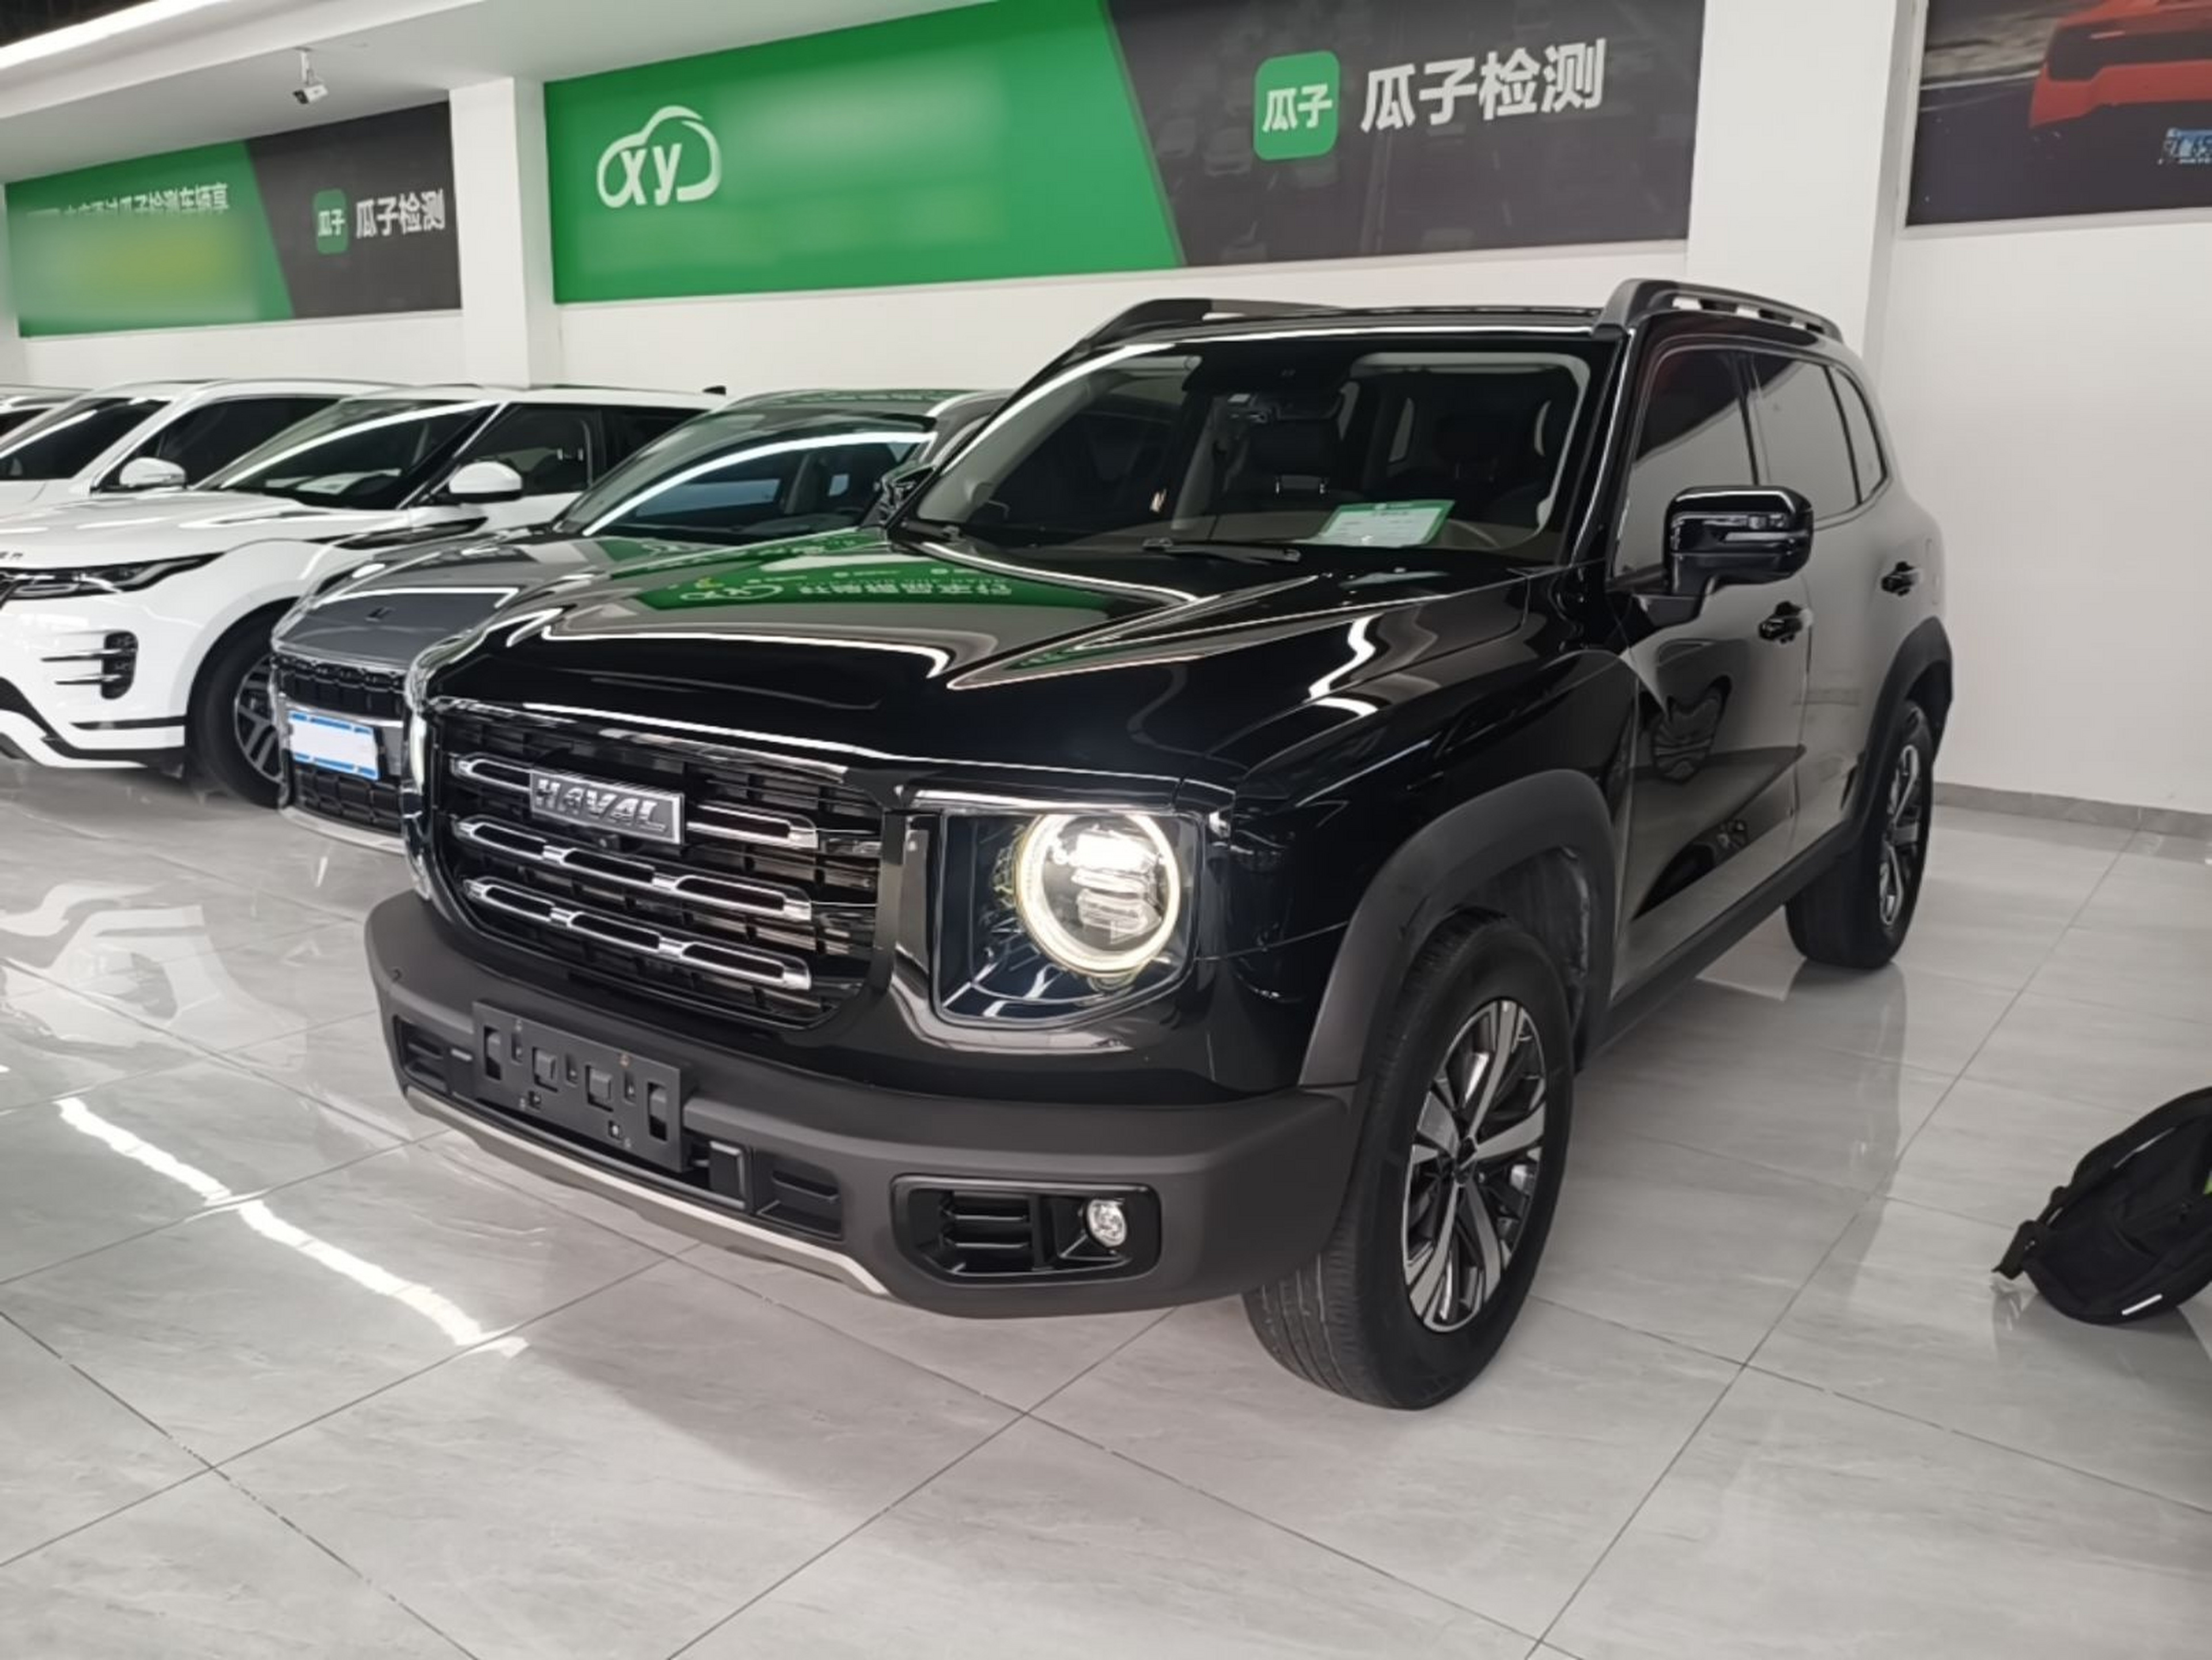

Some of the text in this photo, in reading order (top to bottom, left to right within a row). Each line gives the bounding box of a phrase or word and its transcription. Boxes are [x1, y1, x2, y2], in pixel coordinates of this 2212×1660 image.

[1262, 84, 1333, 133] 瓜子
[1360, 38, 1607, 133] 瓜子检测
[318, 209, 345, 237] 瓜子
[355, 188, 446, 239] 瓜子检测
[536, 778, 666, 831] HAVAL
